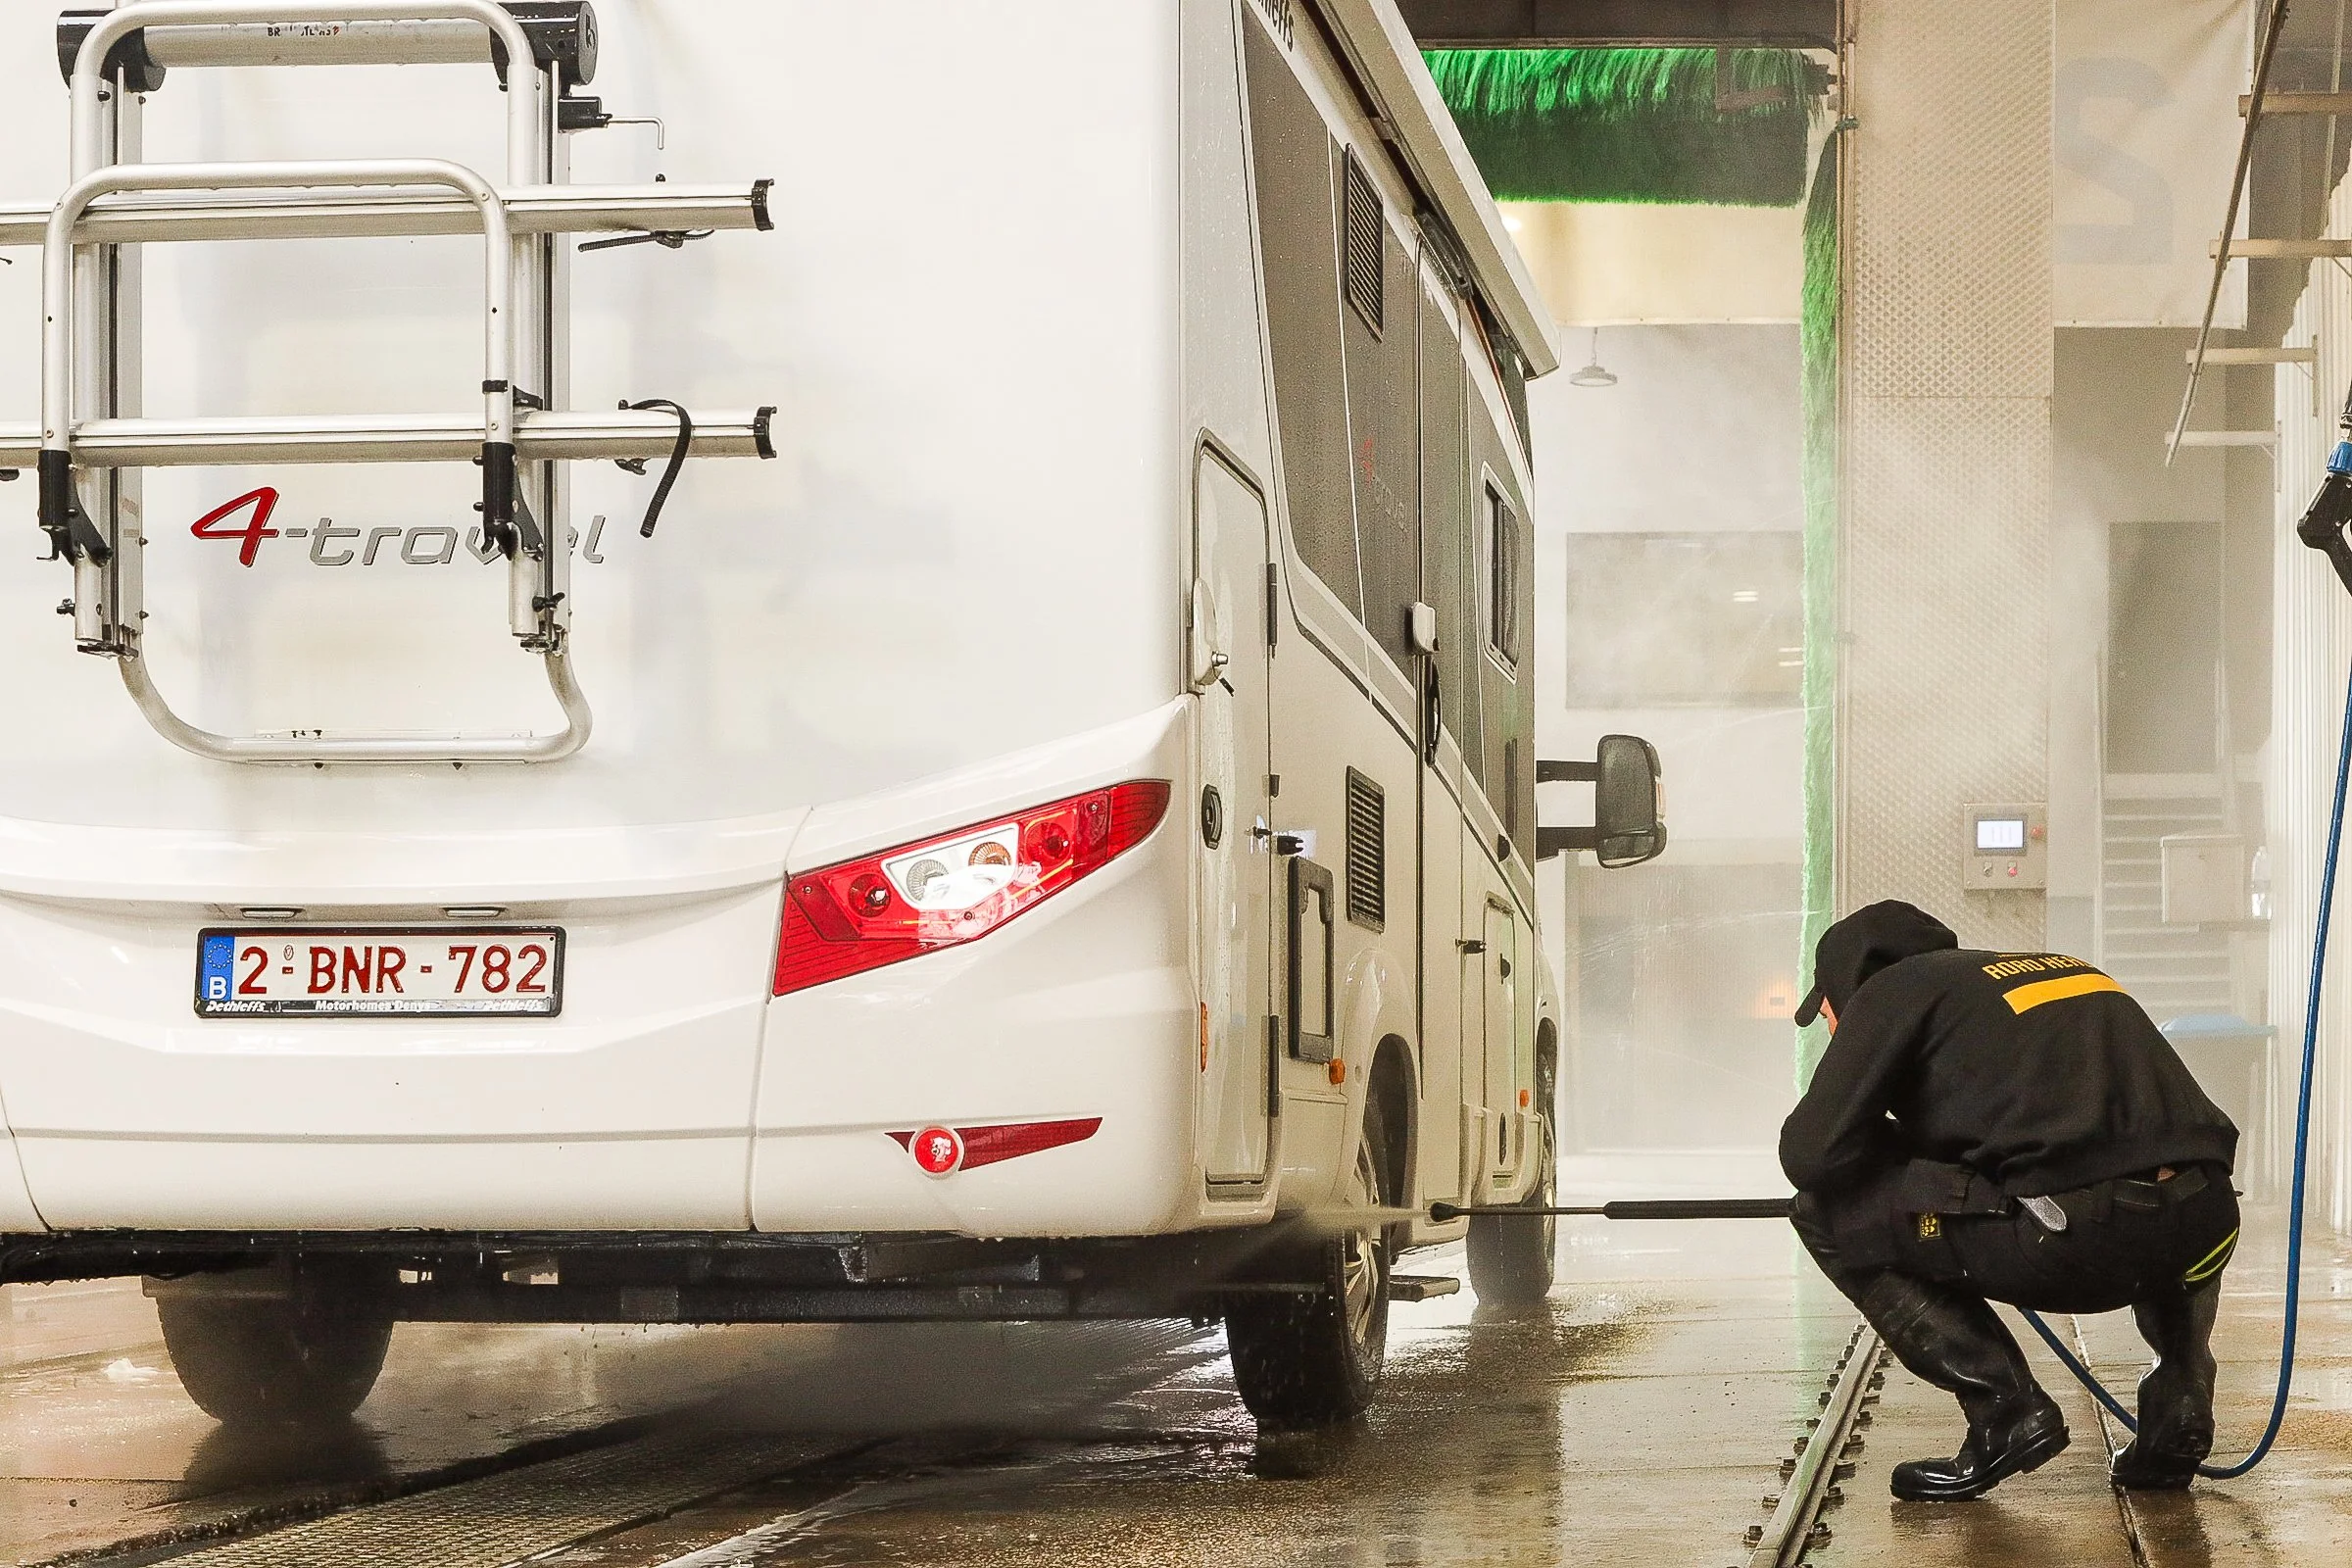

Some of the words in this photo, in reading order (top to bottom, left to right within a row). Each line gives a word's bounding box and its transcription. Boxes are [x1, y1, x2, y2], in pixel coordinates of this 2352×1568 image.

[190, 486, 606, 567] 4-travl
[1982, 959, 2046, 980] ROAD
[208, 975, 227, 1000] B
[206, 1001, 267, 1012] Dethleffs
[316, 1001, 393, 1011] Motorhomes
